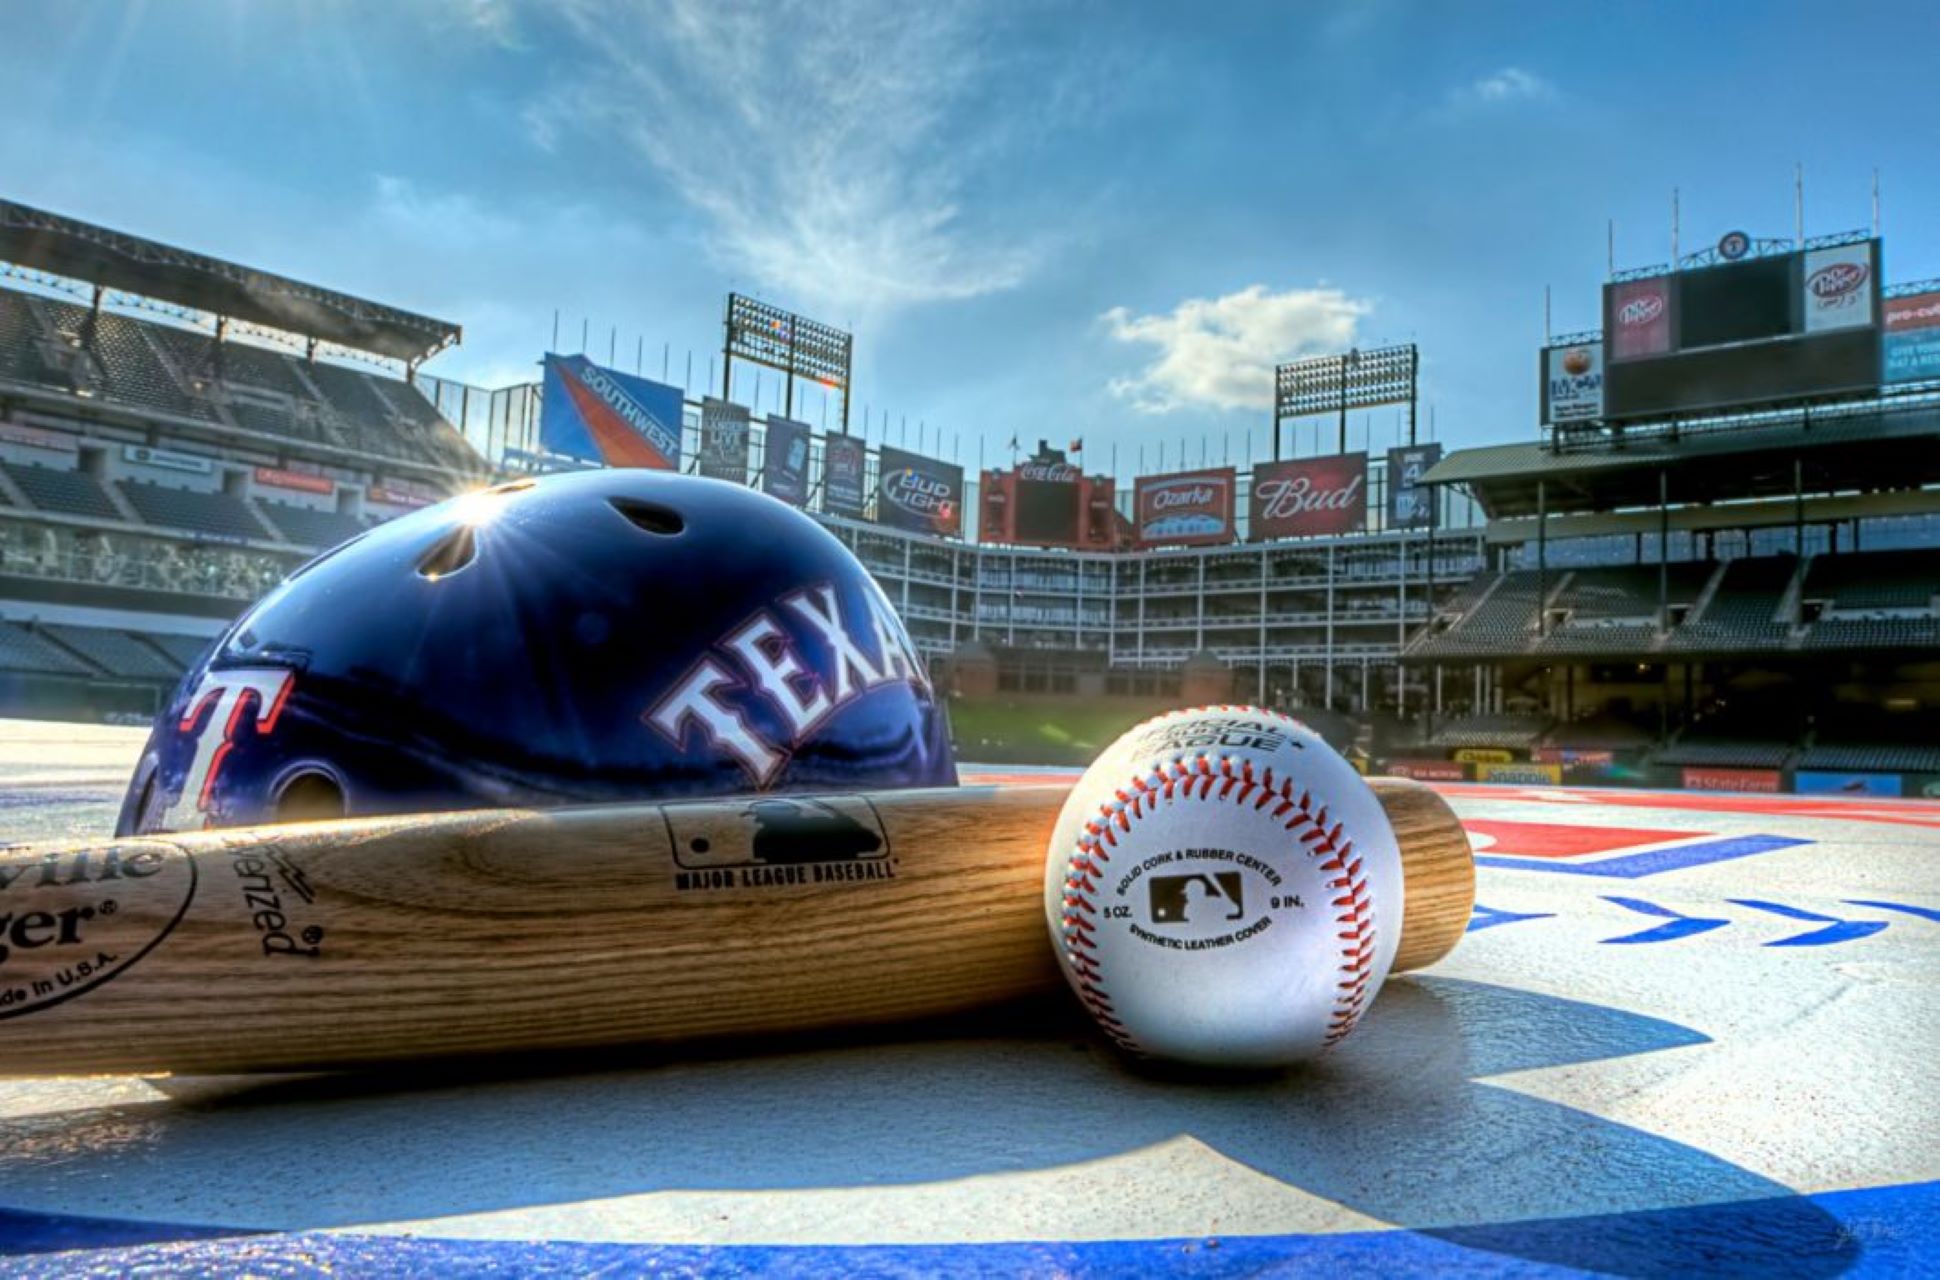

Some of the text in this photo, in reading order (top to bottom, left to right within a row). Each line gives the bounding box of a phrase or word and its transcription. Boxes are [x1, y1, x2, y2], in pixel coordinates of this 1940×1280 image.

[581, 365, 678, 456] SOUTHWEST
[1255, 475, 1362, 520] Bud
[165, 669, 295, 832] T
[675, 860, 896, 891] MAJOR LEAGUE BASEBALL
[1116, 847, 1282, 897] SOLID CORK & RUBBER CENTER
[1103, 906, 1132, 919] 5 OZ.
[1270, 895, 1304, 909] 9 IN.
[1129, 915, 1272, 951] SYNTHETIC LEATHER COVER
